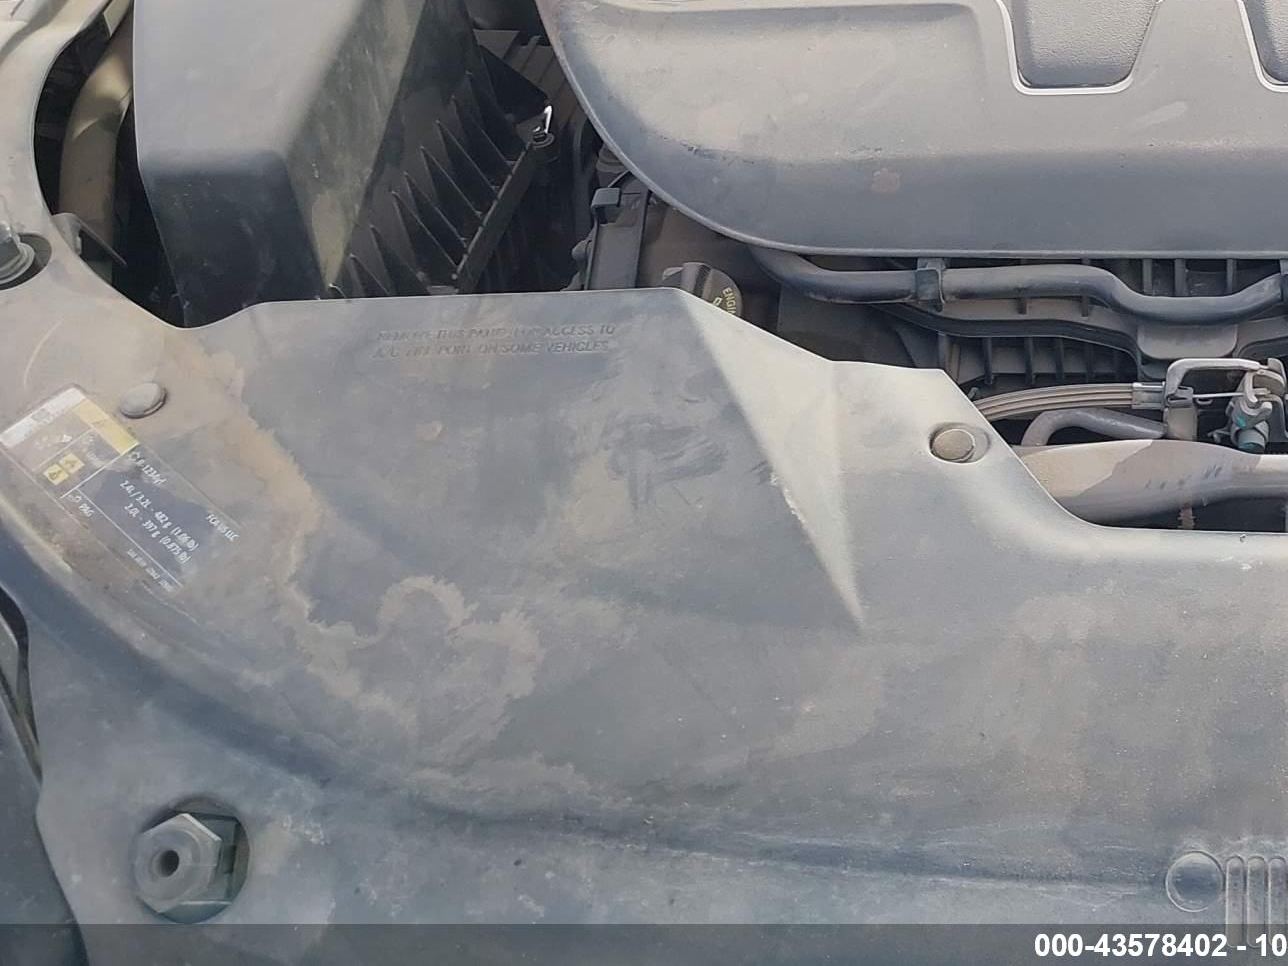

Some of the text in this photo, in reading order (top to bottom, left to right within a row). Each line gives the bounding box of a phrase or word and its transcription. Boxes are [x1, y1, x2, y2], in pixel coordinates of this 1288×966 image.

[436, 329, 465, 340] THIS
[543, 324, 595, 337] ACCESS
[599, 324, 617, 335] TO
[438, 345, 472, 355] PORT
[500, 342, 542, 354] SOME
[544, 340, 610, 353] VEHICLES
